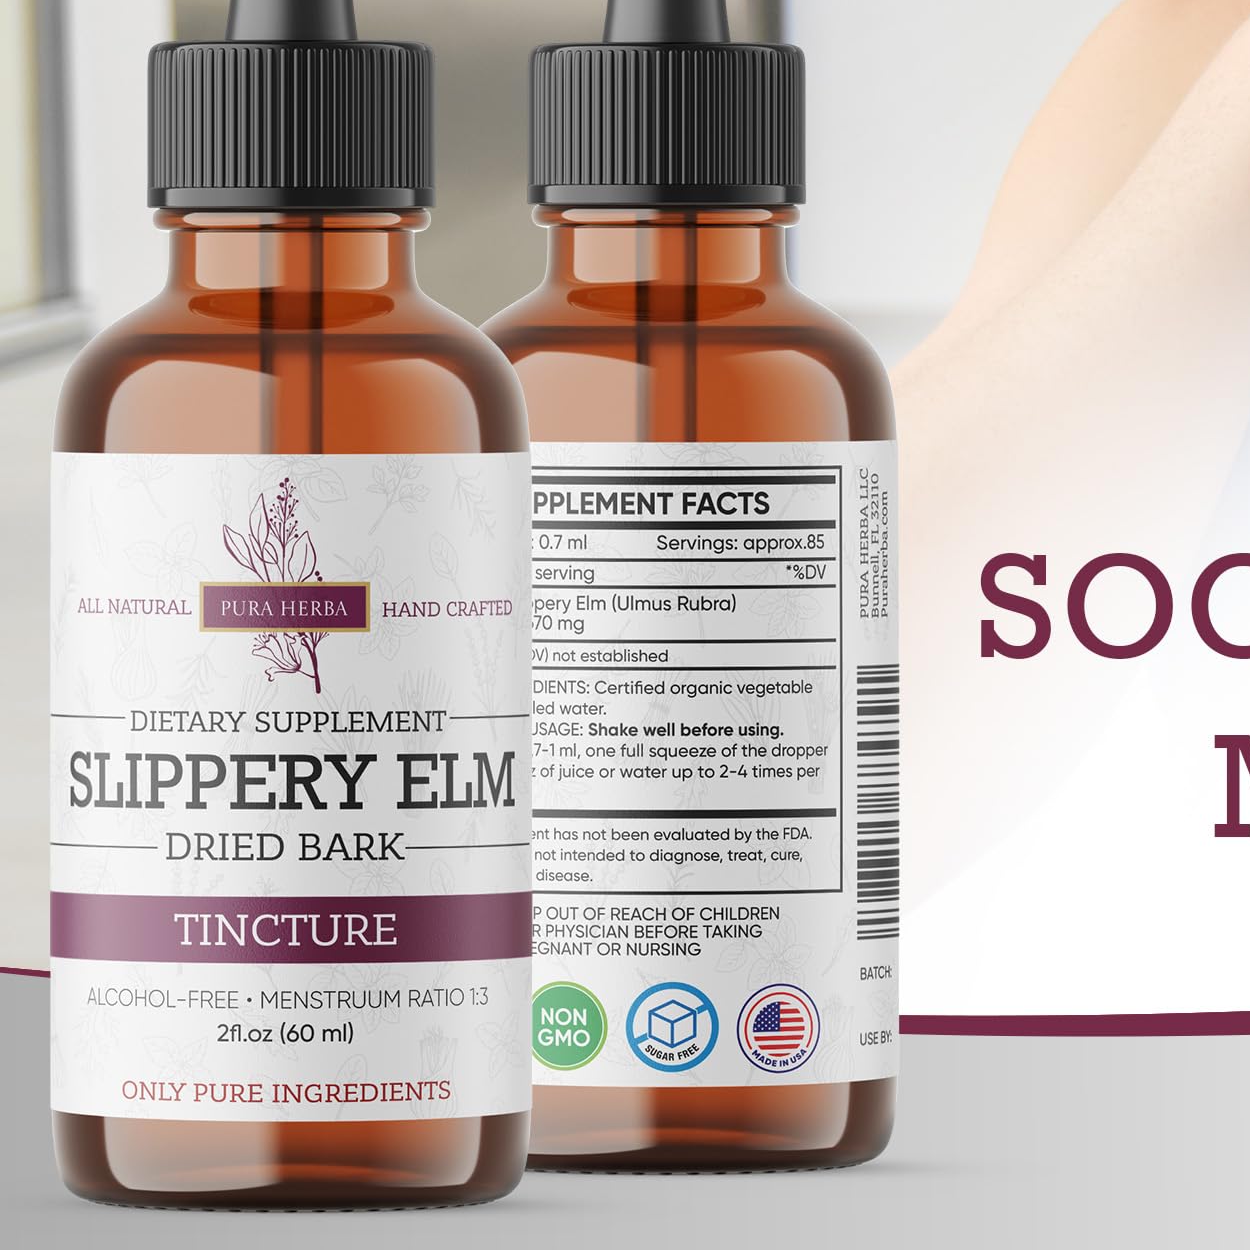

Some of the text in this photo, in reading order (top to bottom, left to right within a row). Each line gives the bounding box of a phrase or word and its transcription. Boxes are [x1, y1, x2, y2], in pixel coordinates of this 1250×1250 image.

[681, 491, 771, 515] FACTS
[539, 534, 562, 550] 0.7
[567, 534, 587, 550] ml
[656, 534, 738, 554] Servings:
[859, 467, 869, 619] PURA HERBA LLC
[870, 472, 881, 619] Bunnell, FL 32110
[880, 491, 888, 618] Puraherba.com
[534, 564, 595, 584] serving
[77, 597, 193, 617] ALL NATURAL
[220, 600, 350, 618] PURA HERBA
[381, 599, 514, 618] HAND CRAFTED
[532, 593, 737, 615] pery Elm (Ulmus Rubra)
[557, 617, 585, 635] mg
[552, 648, 577, 663] not
[580, 648, 669, 663] established
[594, 680, 666, 696] Certified
[670, 680, 733, 699] organic
[736, 680, 813, 698] vegetable
[559, 702, 607, 716] water.
[130, 709, 447, 734] DIETARY SUPPLEMENT
[587, 722, 638, 738] Shake
[643, 722, 676, 738] well
[680, 722, 734, 738] before
[737, 722, 785, 740] using.
[558, 743, 581, 760] ml,
[585, 746, 616, 758] one
[620, 743, 645, 758] full
[648, 745, 718, 761] squeeze
[721, 743, 738, 758] of
[740, 743, 768, 758] the
[771, 743, 829, 760] dropper
[69, 749, 516, 811] SLIPPERY ELM
[539, 764, 557, 778] of
[557, 764, 595, 781] juice
[598, 765, 616, 779] or
[620, 765, 669, 780] water
[672, 765, 694, 782] up
[697, 764, 716, 780] to
[718, 764, 749, 779] 2-4
[751, 764, 794, 780] times
[796, 765, 821, 781] per
[553, 827, 579, 841] has
[582, 828, 608, 841] not
[611, 827, 650, 841] been
[653, 827, 730, 842] evaluated
[734, 827, 753, 844] by
[756, 827, 780, 841] the
[782, 827, 813, 841] FDA.
[165, 831, 406, 862] DRIED BARK
[534, 848, 804, 865] not intended to diagnose, treat, cure,
[535, 868, 594, 883] disease.
[545, 907, 579, 921] OUT
[583, 907, 607, 921] OF
[611, 907, 668, 922] REACH
[671, 907, 696, 922] OF
[700, 905, 780, 921] CHILDREN
[173, 912, 399, 947] TINCTURE
[545, 924, 629, 939] PHYSICIAN
[634, 924, 699, 939] BEFORE
[702, 924, 763, 939] TAKING
[598, 942, 621, 957] OR
[625, 942, 702, 957] NURSING
[860, 965, 892, 980] BATCH:
[86, 986, 489, 1011] ALCOHOL-FREE MENSTRUUM RATIO 1:3
[540, 1008, 588, 1026] NON
[216, 1020, 355, 1045] 2fl.oz (60 ml)
[537, 1028, 591, 1047] GMO
[860, 1030, 892, 1046] USE BY:
[644, 1043, 700, 1061] SUGAR FREE
[751, 1049, 807, 1068] MADE IN USA
[121, 1079, 452, 1105] ONLY PURE INGREDIENTS
